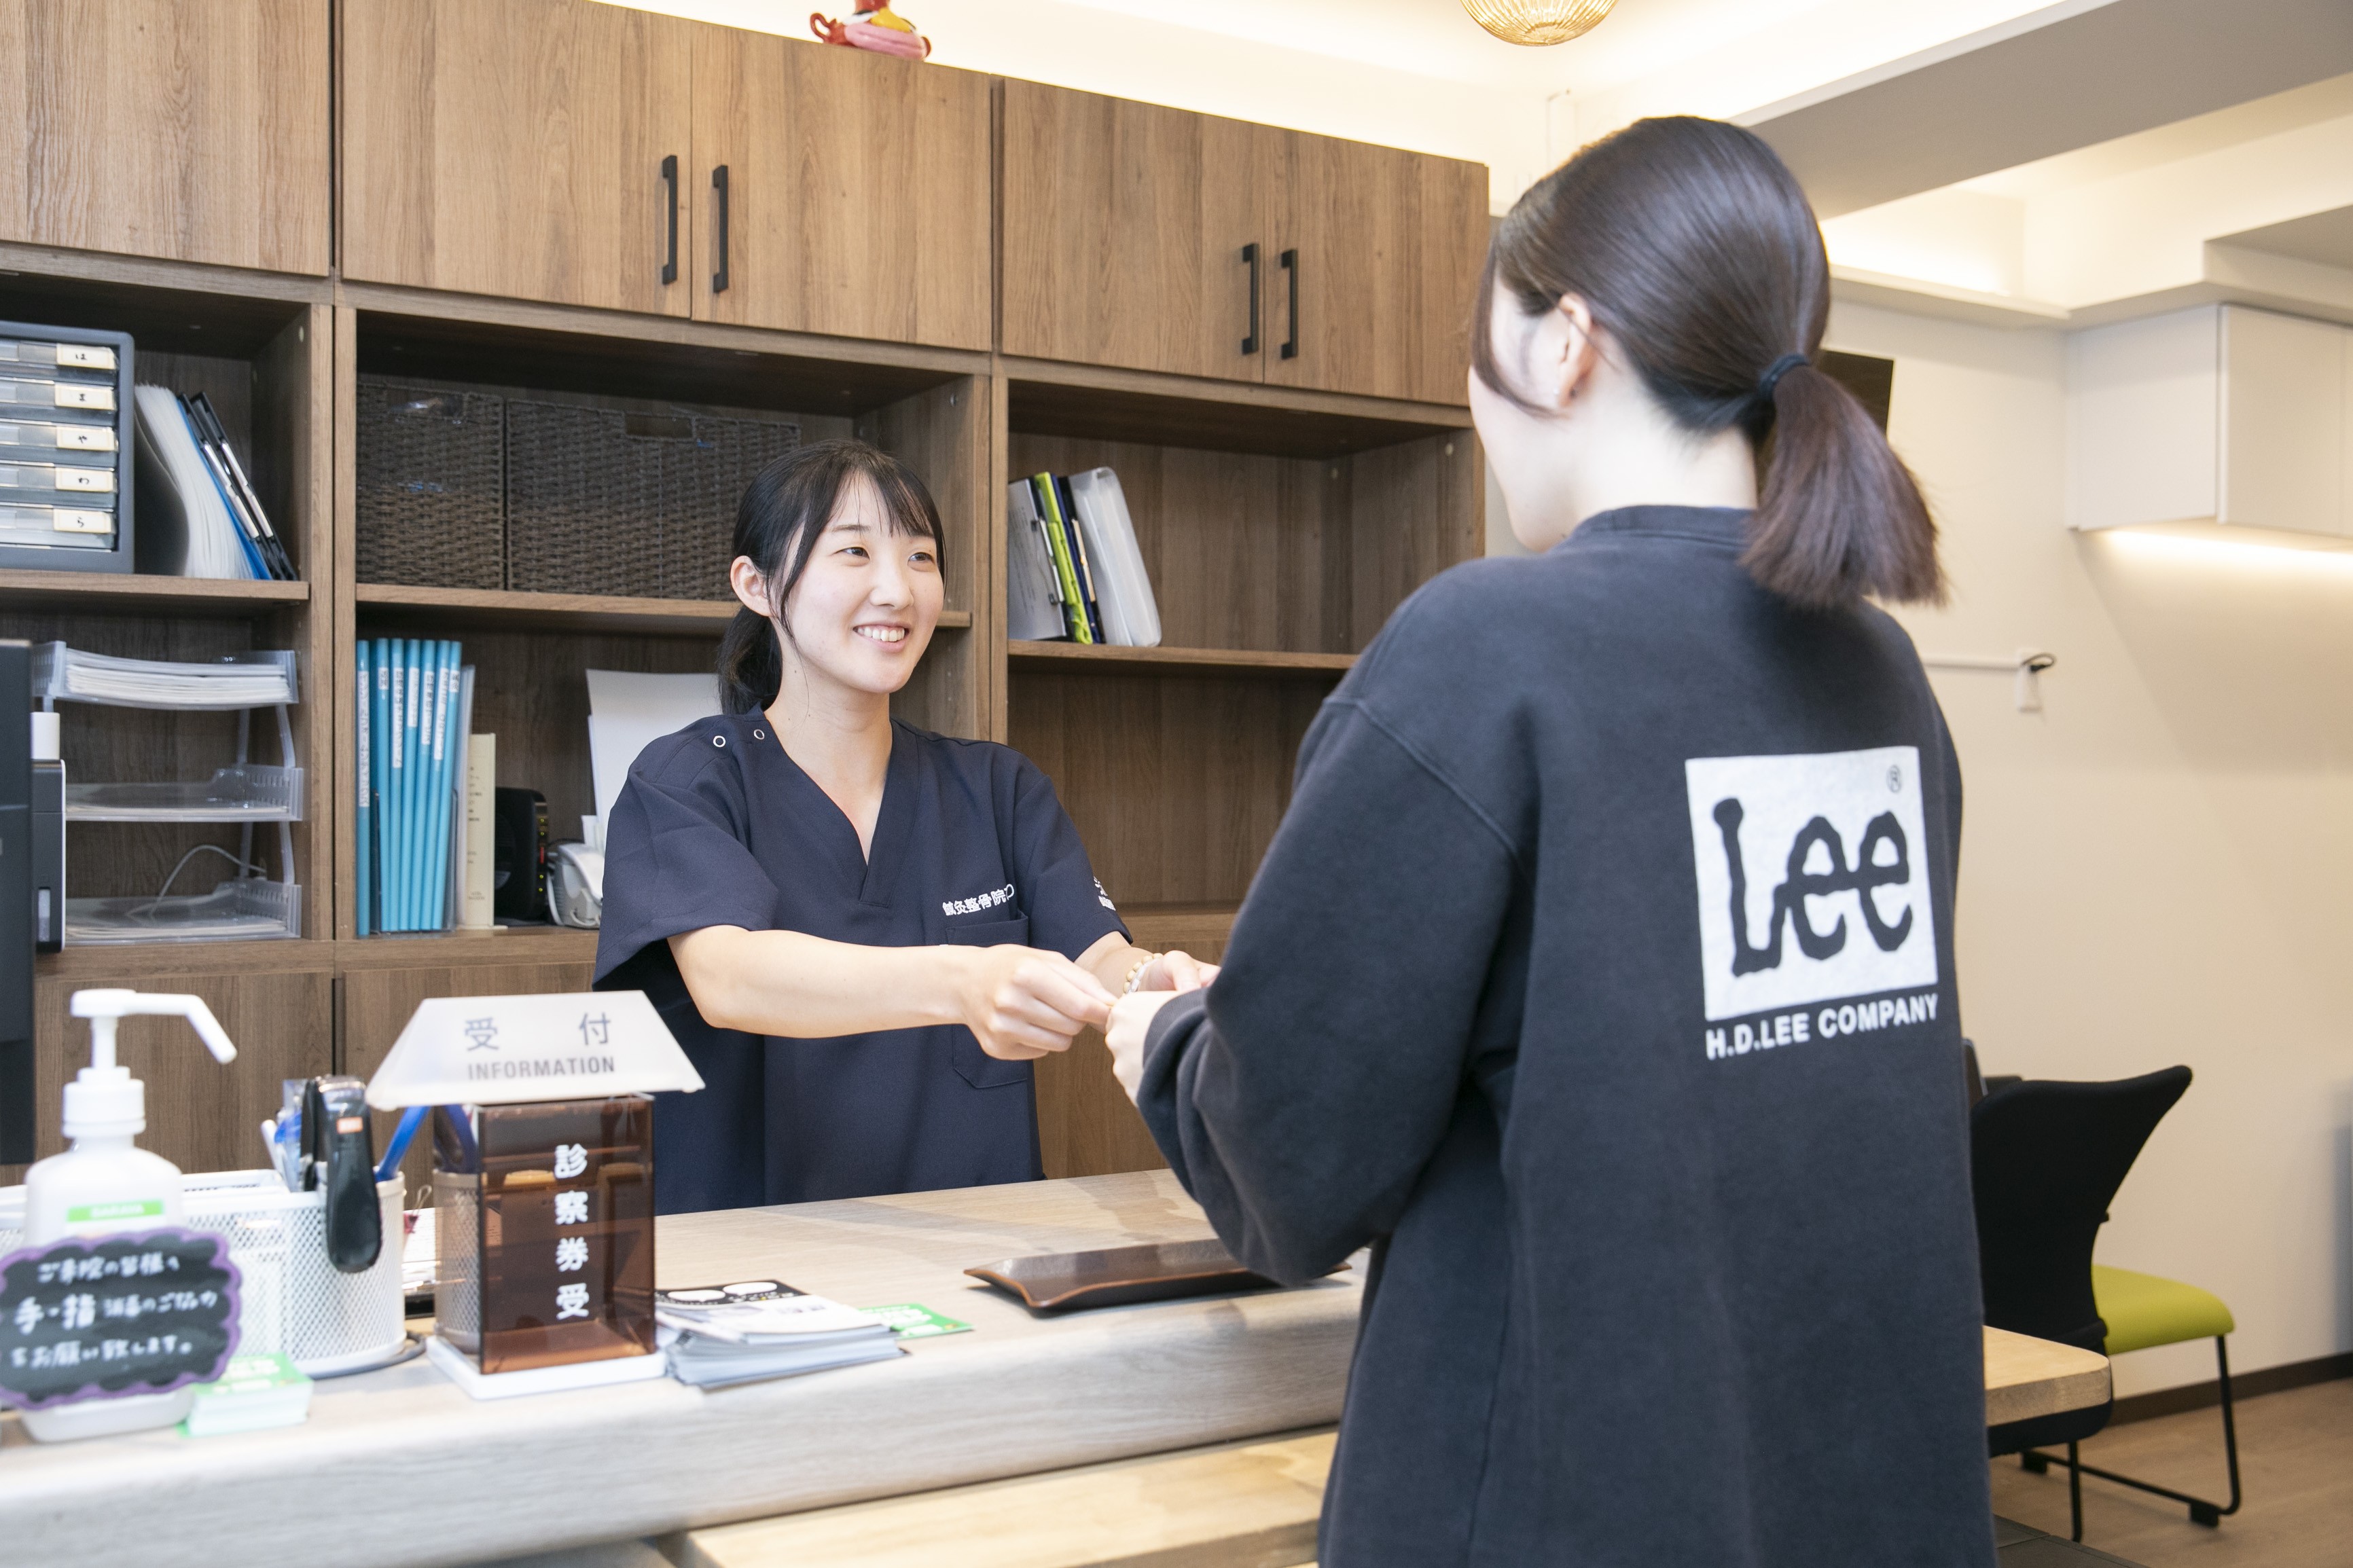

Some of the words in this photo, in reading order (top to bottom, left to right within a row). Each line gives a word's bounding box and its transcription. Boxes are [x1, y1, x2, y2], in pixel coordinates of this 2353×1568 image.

[1706, 1013, 1810, 1060] H.D.LEE
[1818, 993, 1939, 1038] COMPANY
[467, 1056, 616, 1080] INFORMATION
[554, 1143, 590, 1321] 診察券受
